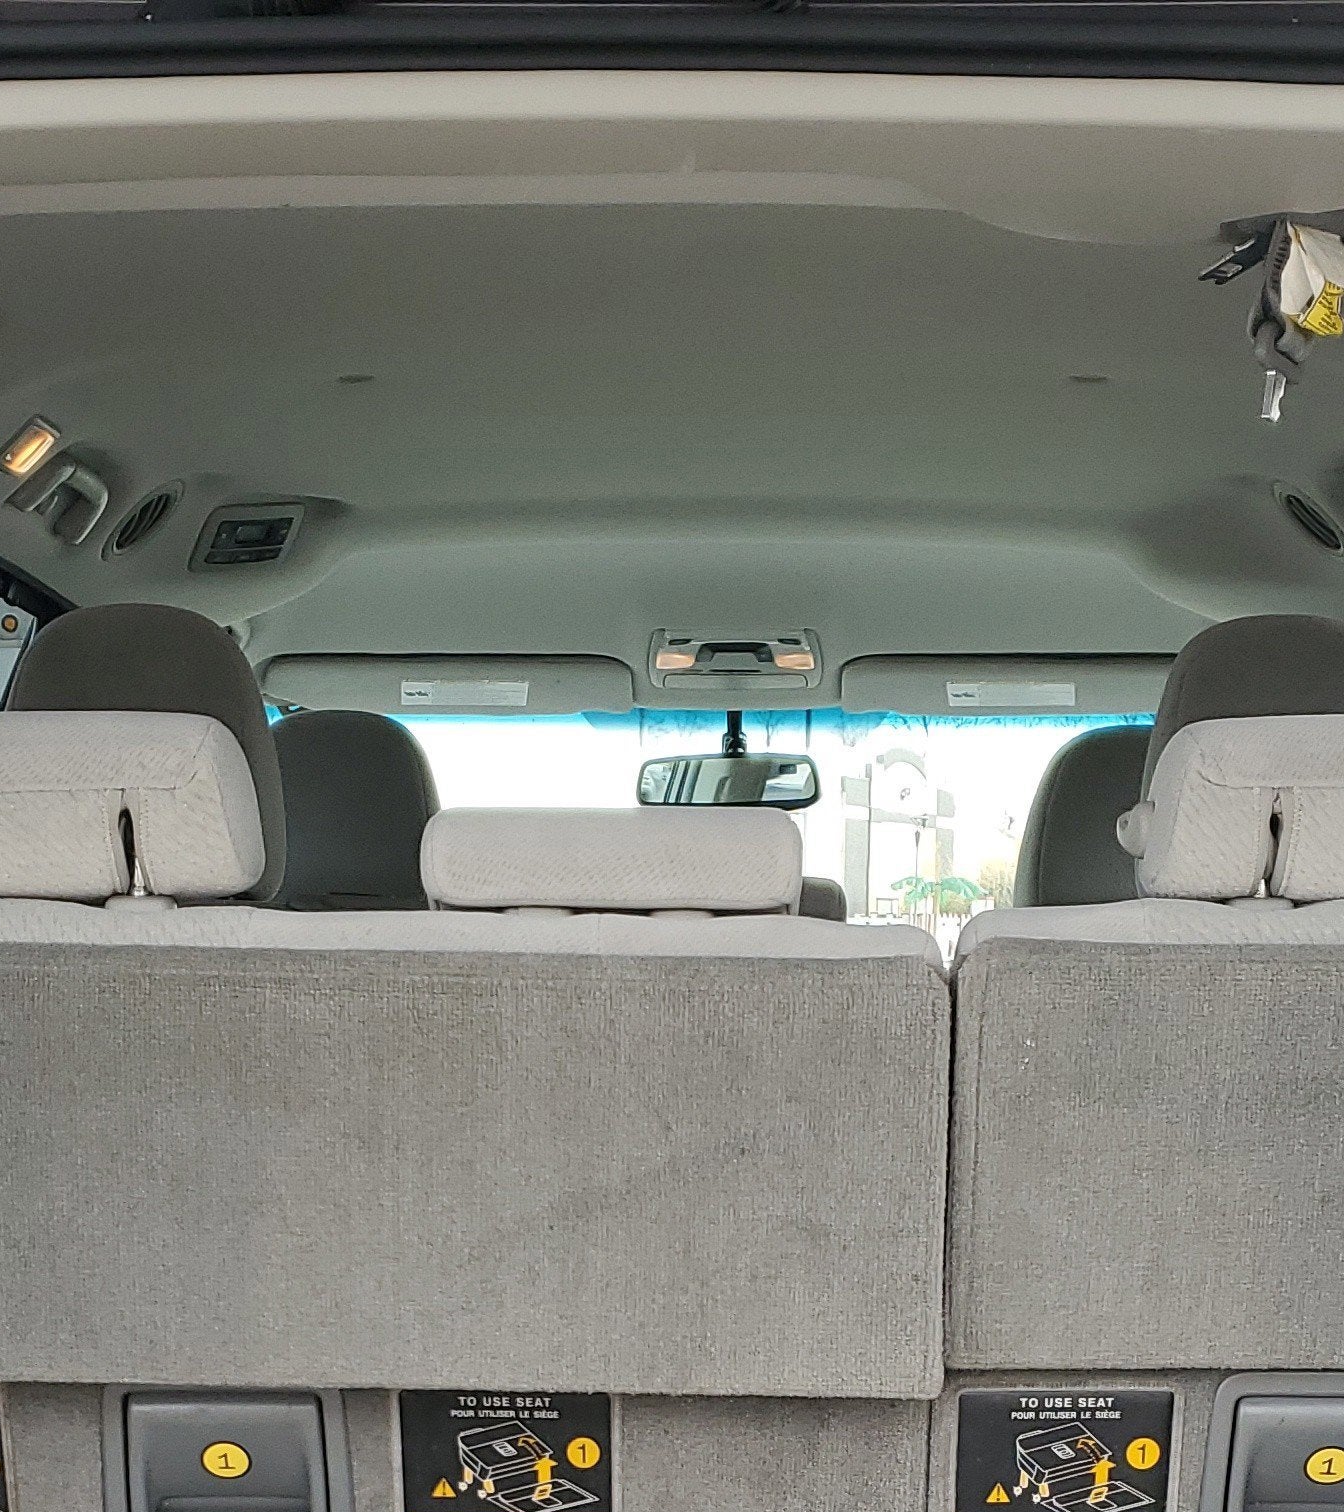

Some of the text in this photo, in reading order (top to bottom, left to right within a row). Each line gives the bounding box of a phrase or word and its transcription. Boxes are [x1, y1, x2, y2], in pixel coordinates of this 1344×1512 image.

[458, 1396, 552, 1408] TO USE SEAT
[1019, 1397, 1115, 1408] TO USE SEAT
[450, 1410, 474, 1418] POUR
[478, 1410, 516, 1418] UTILISER
[519, 1410, 530, 1418] LE
[1011, 1411, 1035, 1420] POUR
[1039, 1411, 1077, 1420] UTILISER
[1081, 1411, 1092, 1420] LE
[218, 1452, 236, 1470] 1
[577, 1443, 587, 1464] 1
[1137, 1443, 1147, 1465] 1
[1318, 1457, 1338, 1476] 1
